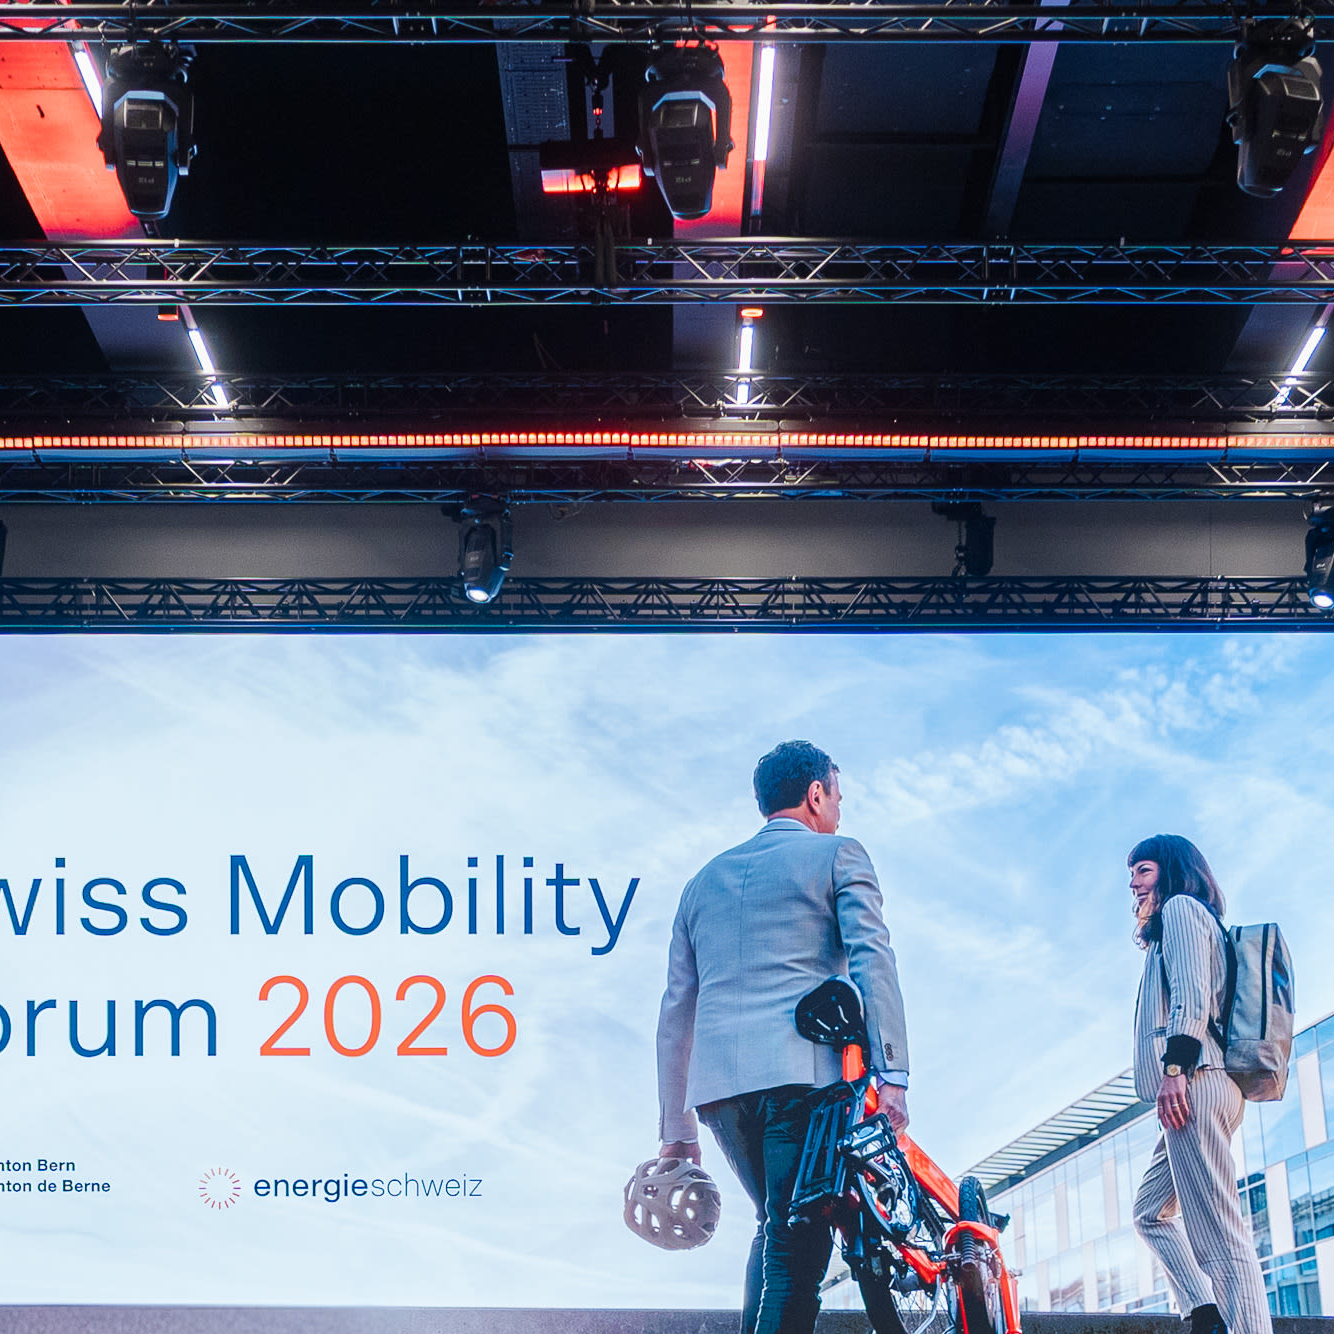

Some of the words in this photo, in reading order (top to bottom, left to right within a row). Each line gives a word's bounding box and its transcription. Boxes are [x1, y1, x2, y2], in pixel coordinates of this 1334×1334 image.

[230, 855, 641, 955] Mobility
[258, 974, 517, 1058] 2026
[38, 1158, 76, 1172] Bern
[38, 1179, 57, 1193] de
[62, 1179, 111, 1193] Berne
[253, 1171, 483, 1203] energieschweiz
